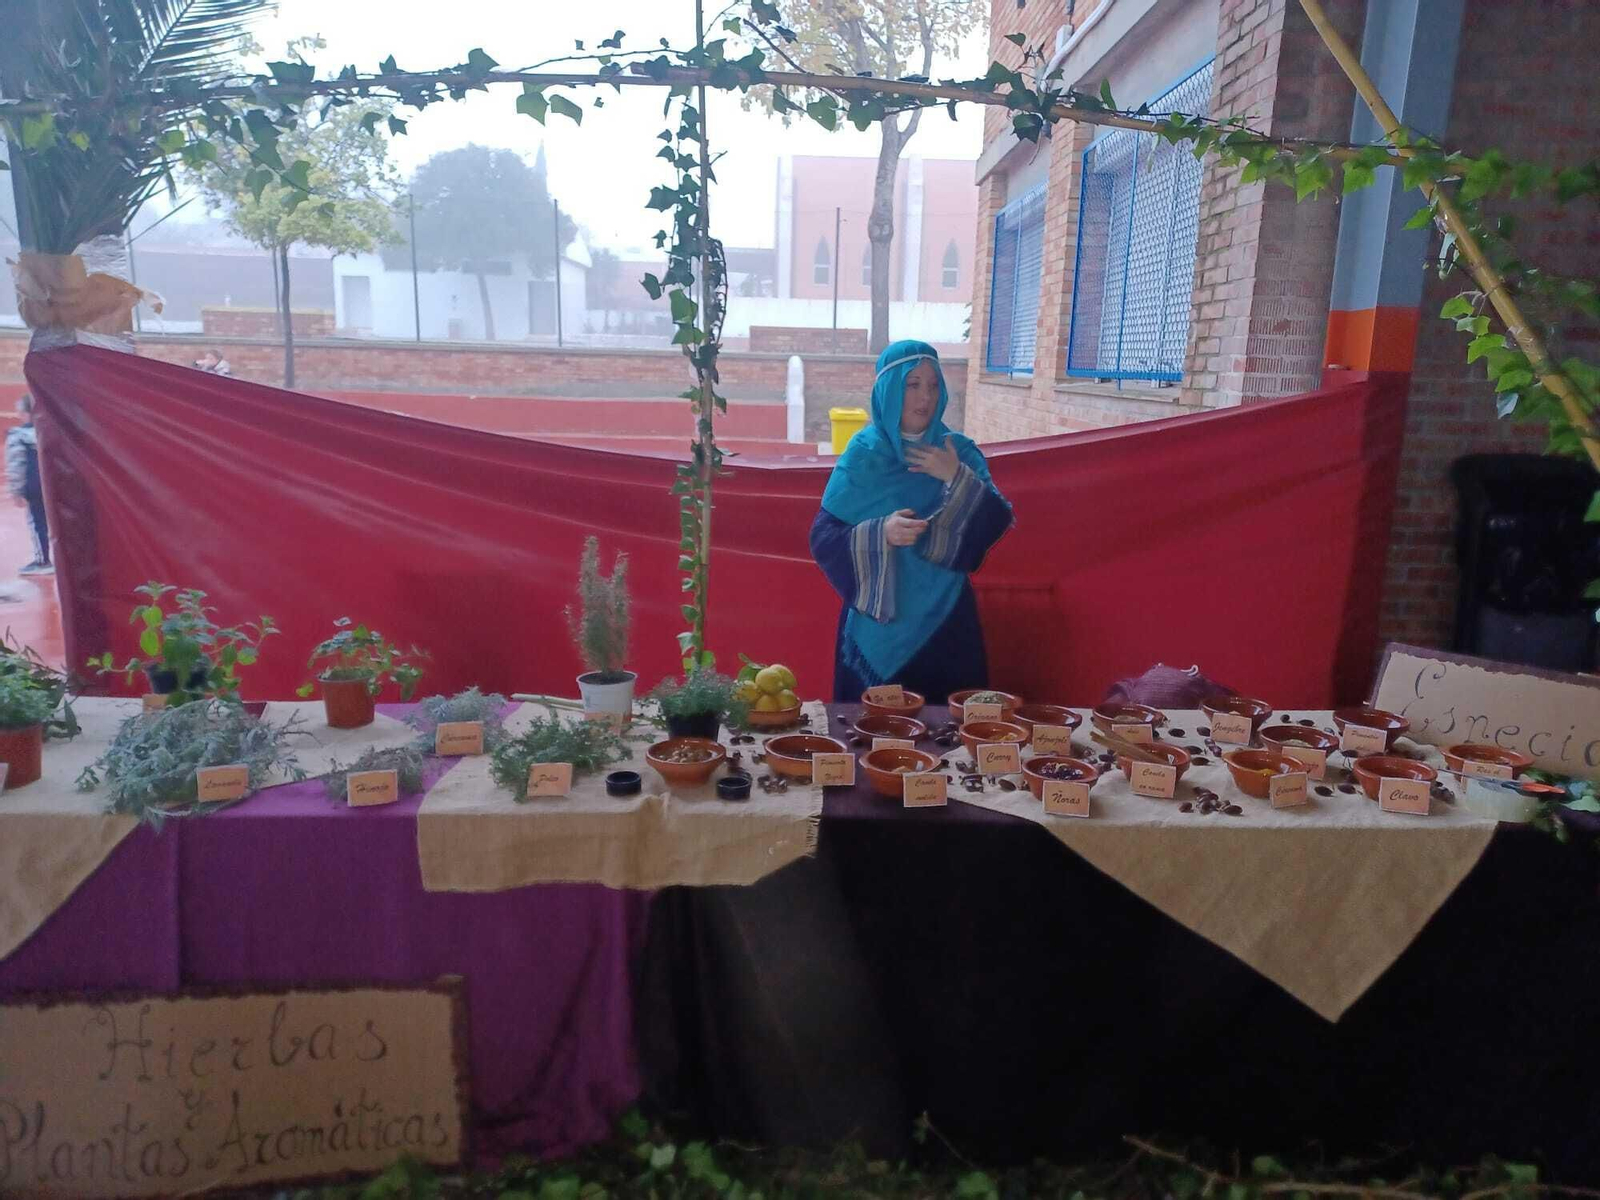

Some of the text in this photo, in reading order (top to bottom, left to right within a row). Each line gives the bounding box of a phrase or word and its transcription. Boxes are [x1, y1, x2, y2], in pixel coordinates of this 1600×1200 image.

[1212, 721, 1246, 734] Jengibre
[986, 752, 1012, 764] Curry
[1052, 789, 1081, 805] Ñoras
[1389, 789, 1420, 802] Clavo
[82, 1001, 388, 1082] Hierbas
[0, 1089, 449, 1182] Plantas Aromáticas
